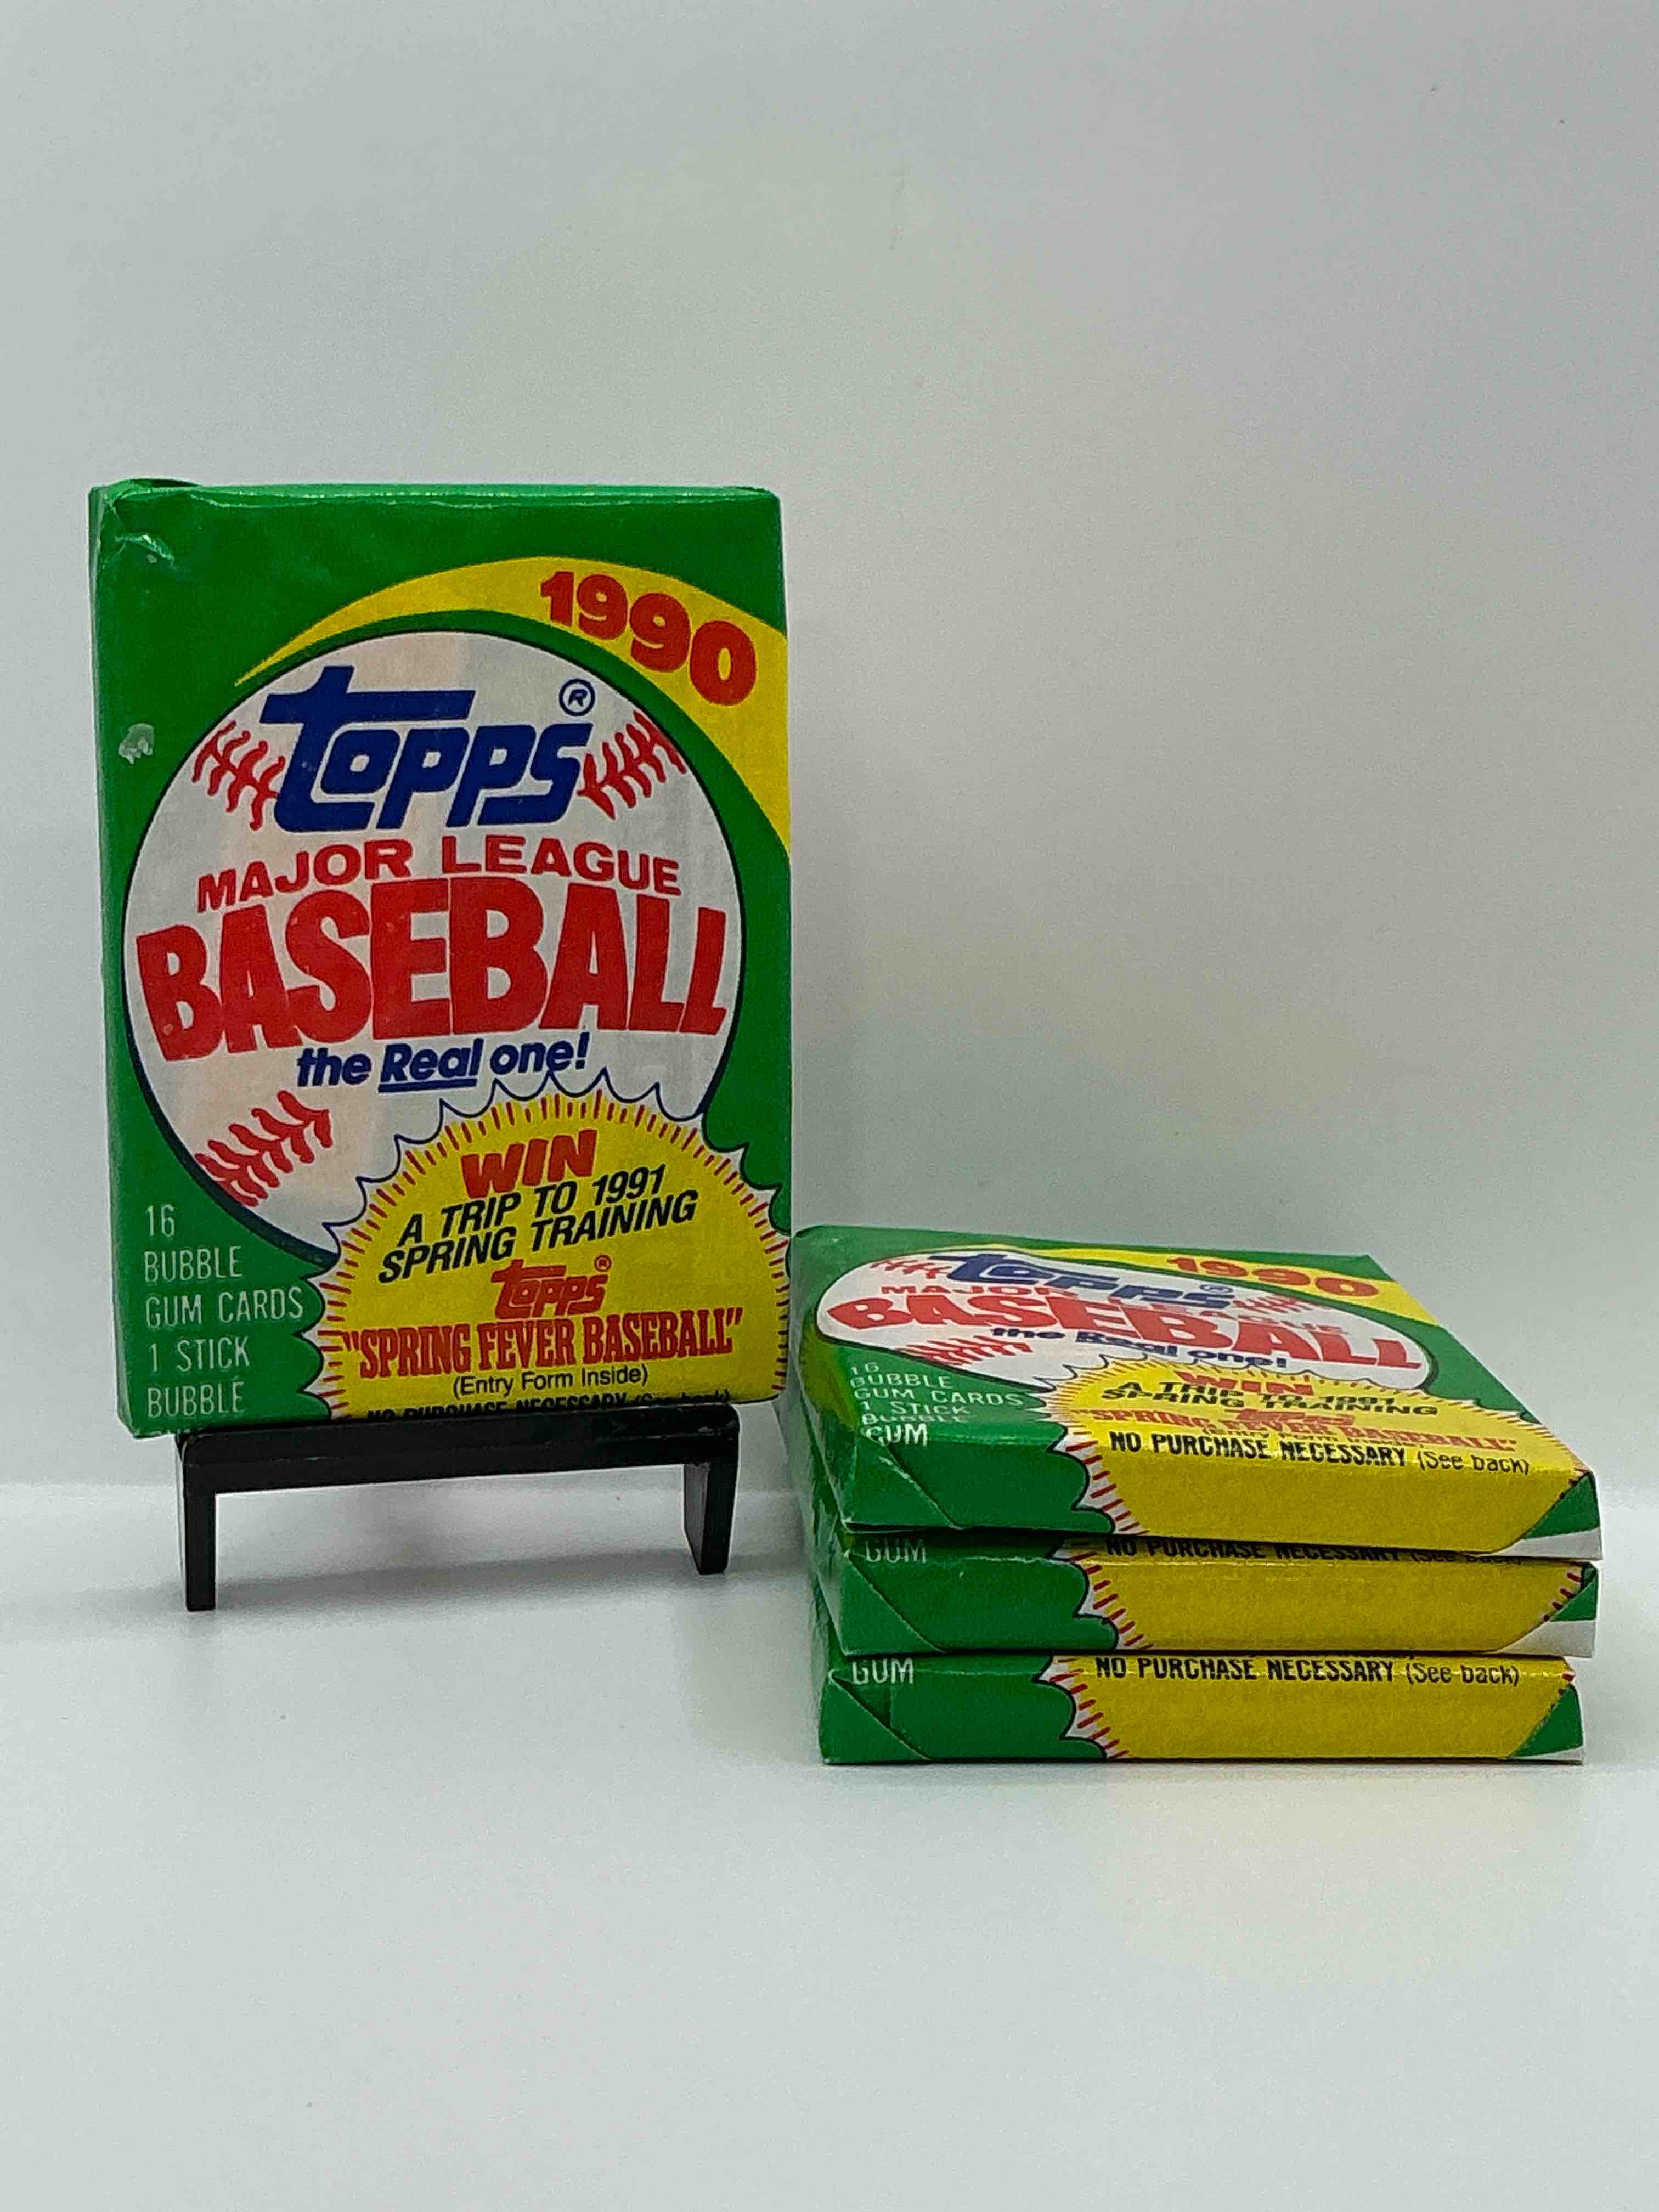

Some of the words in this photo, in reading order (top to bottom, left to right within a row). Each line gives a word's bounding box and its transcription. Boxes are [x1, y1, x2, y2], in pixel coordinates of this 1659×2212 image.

[540, 571, 757, 706] 1990
[198, 839, 414, 913] MAJOR
[442, 834, 682, 896] LEAGUE
[136, 877, 727, 1062] BASEBALL
[296, 1047, 371, 1087] the
[377, 1037, 484, 1087] Real
[490, 1031, 590, 1075] one!
[461, 1129, 597, 1198] WIN
[146, 1204, 176, 1238] 16
[397, 1214, 423, 1247] A
[441, 1192, 521, 1239] TRIP
[535, 1181, 577, 1217] TO
[593, 1164, 667, 1206] 1991
[378, 1226, 517, 1284] SPRING
[532, 1189, 698, 1252] TRAINING
[144, 1246, 242, 1283] BUBBLE
[1167, 1256, 1378, 1297] 1990
[145, 1294, 202, 1329] GUM
[219, 1286, 303, 1323] CARDS
[881, 1285, 1078, 1297] MAJOR
[342, 1324, 471, 1379] "SPRING
[477, 1312, 576, 1370] FEVER
[583, 1307, 743, 1361] BASEBALL"
[827, 1295, 1422, 1369] BASEBALL
[1075, 1331, 1177, 1357] Real
[150, 1343, 158, 1372] 1
[176, 1336, 250, 1372] STICK
[453, 1375, 514, 1400] (Entry
[522, 1371, 573, 1392] Form
[582, 1364, 648, 1386] Inside)
[850, 1374, 953, 1389] BUBBLE
[854, 1388, 915, 1400] GUM
[931, 1390, 1024, 1406] CARDS
[1175, 1372, 1314, 1396] WIN
[147, 1381, 246, 1419] BUBBLE
[890, 1401, 971, 1415] STICK
[1101, 1388, 1245, 1408] SPRING
[1264, 1400, 1438, 1415] TRAINING
[866, 1423, 928, 1447] GUM
[1109, 1431, 1141, 1453] NO
[1152, 1433, 1272, 1459] PURCHASE
[1279, 1440, 1405, 1466] NECESSARY
[1418, 1450, 1464, 1471] (See
[1472, 1454, 1530, 1475] back)
[1146, 1539, 1267, 1559] PURCHASE
[852, 1657, 914, 1685] GUM
[1095, 1657, 1127, 1679] NO
[1137, 1657, 1257, 1680] PURCHASE
[1266, 1658, 1393, 1682] NECESSARY
[1406, 1662, 1452, 1685] (See
[1460, 1664, 1520, 1687] back)
